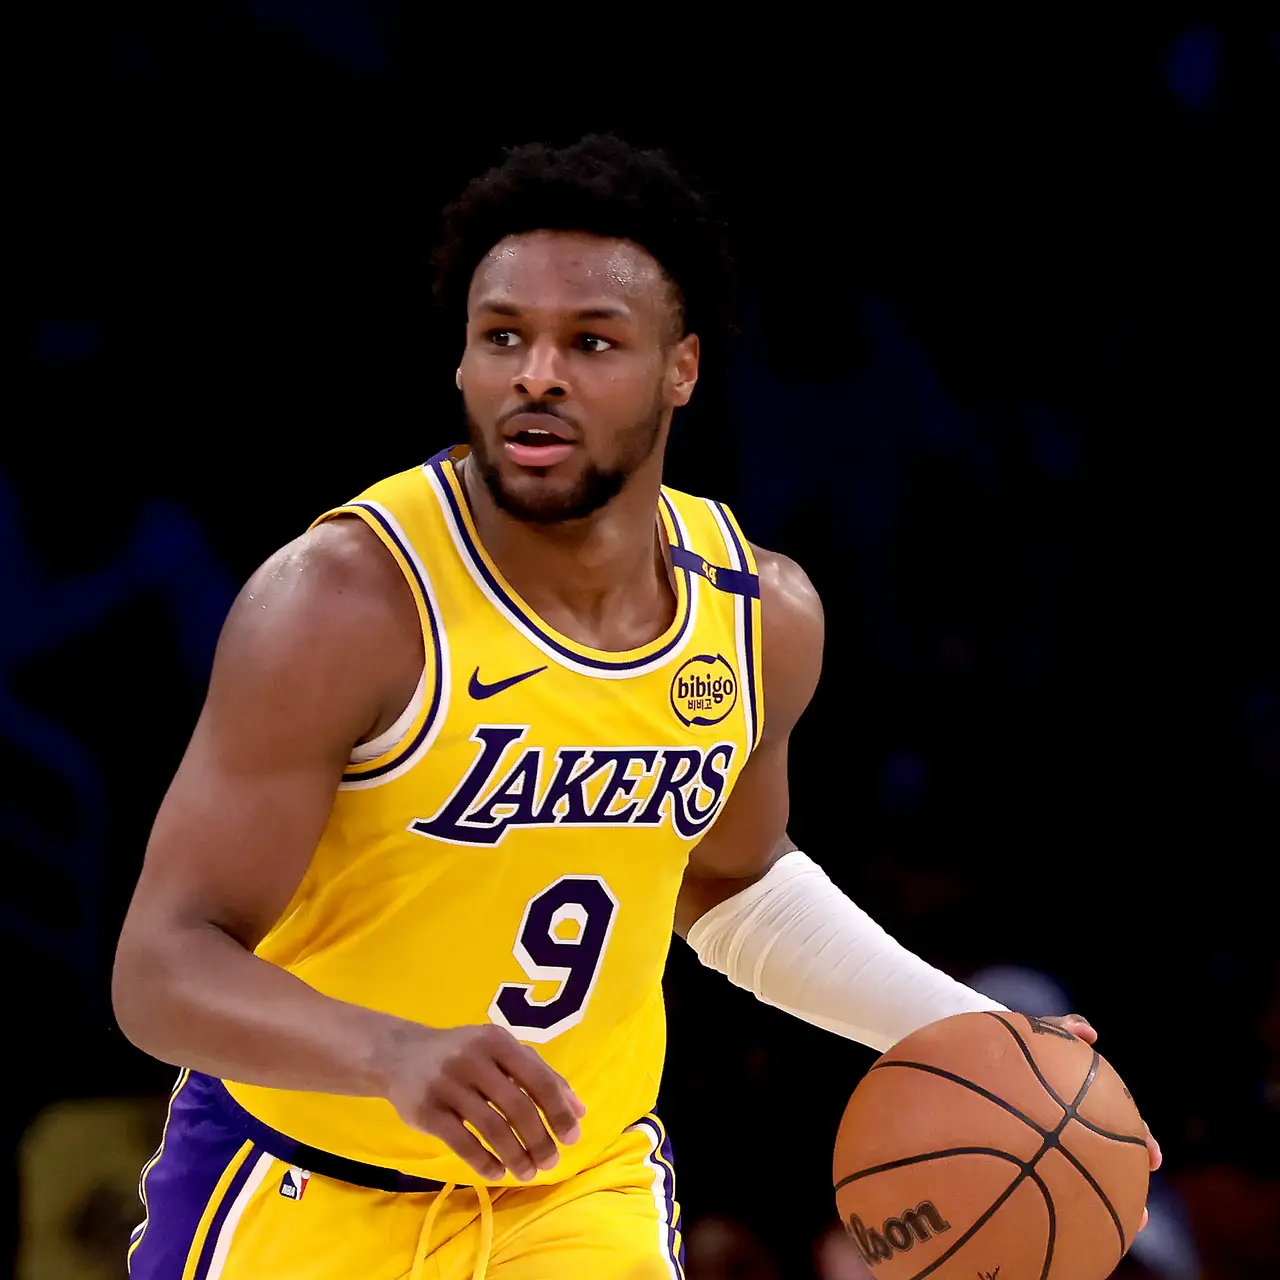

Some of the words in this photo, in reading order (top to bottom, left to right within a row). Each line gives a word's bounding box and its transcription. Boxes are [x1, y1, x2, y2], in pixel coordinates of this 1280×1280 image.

[678, 673, 733, 704] bibigo
[687, 698, 712, 710] 비비고
[408, 725, 737, 847] LAKERS
[488, 874, 620, 1044] 9
[847, 1199, 953, 1267] lson
